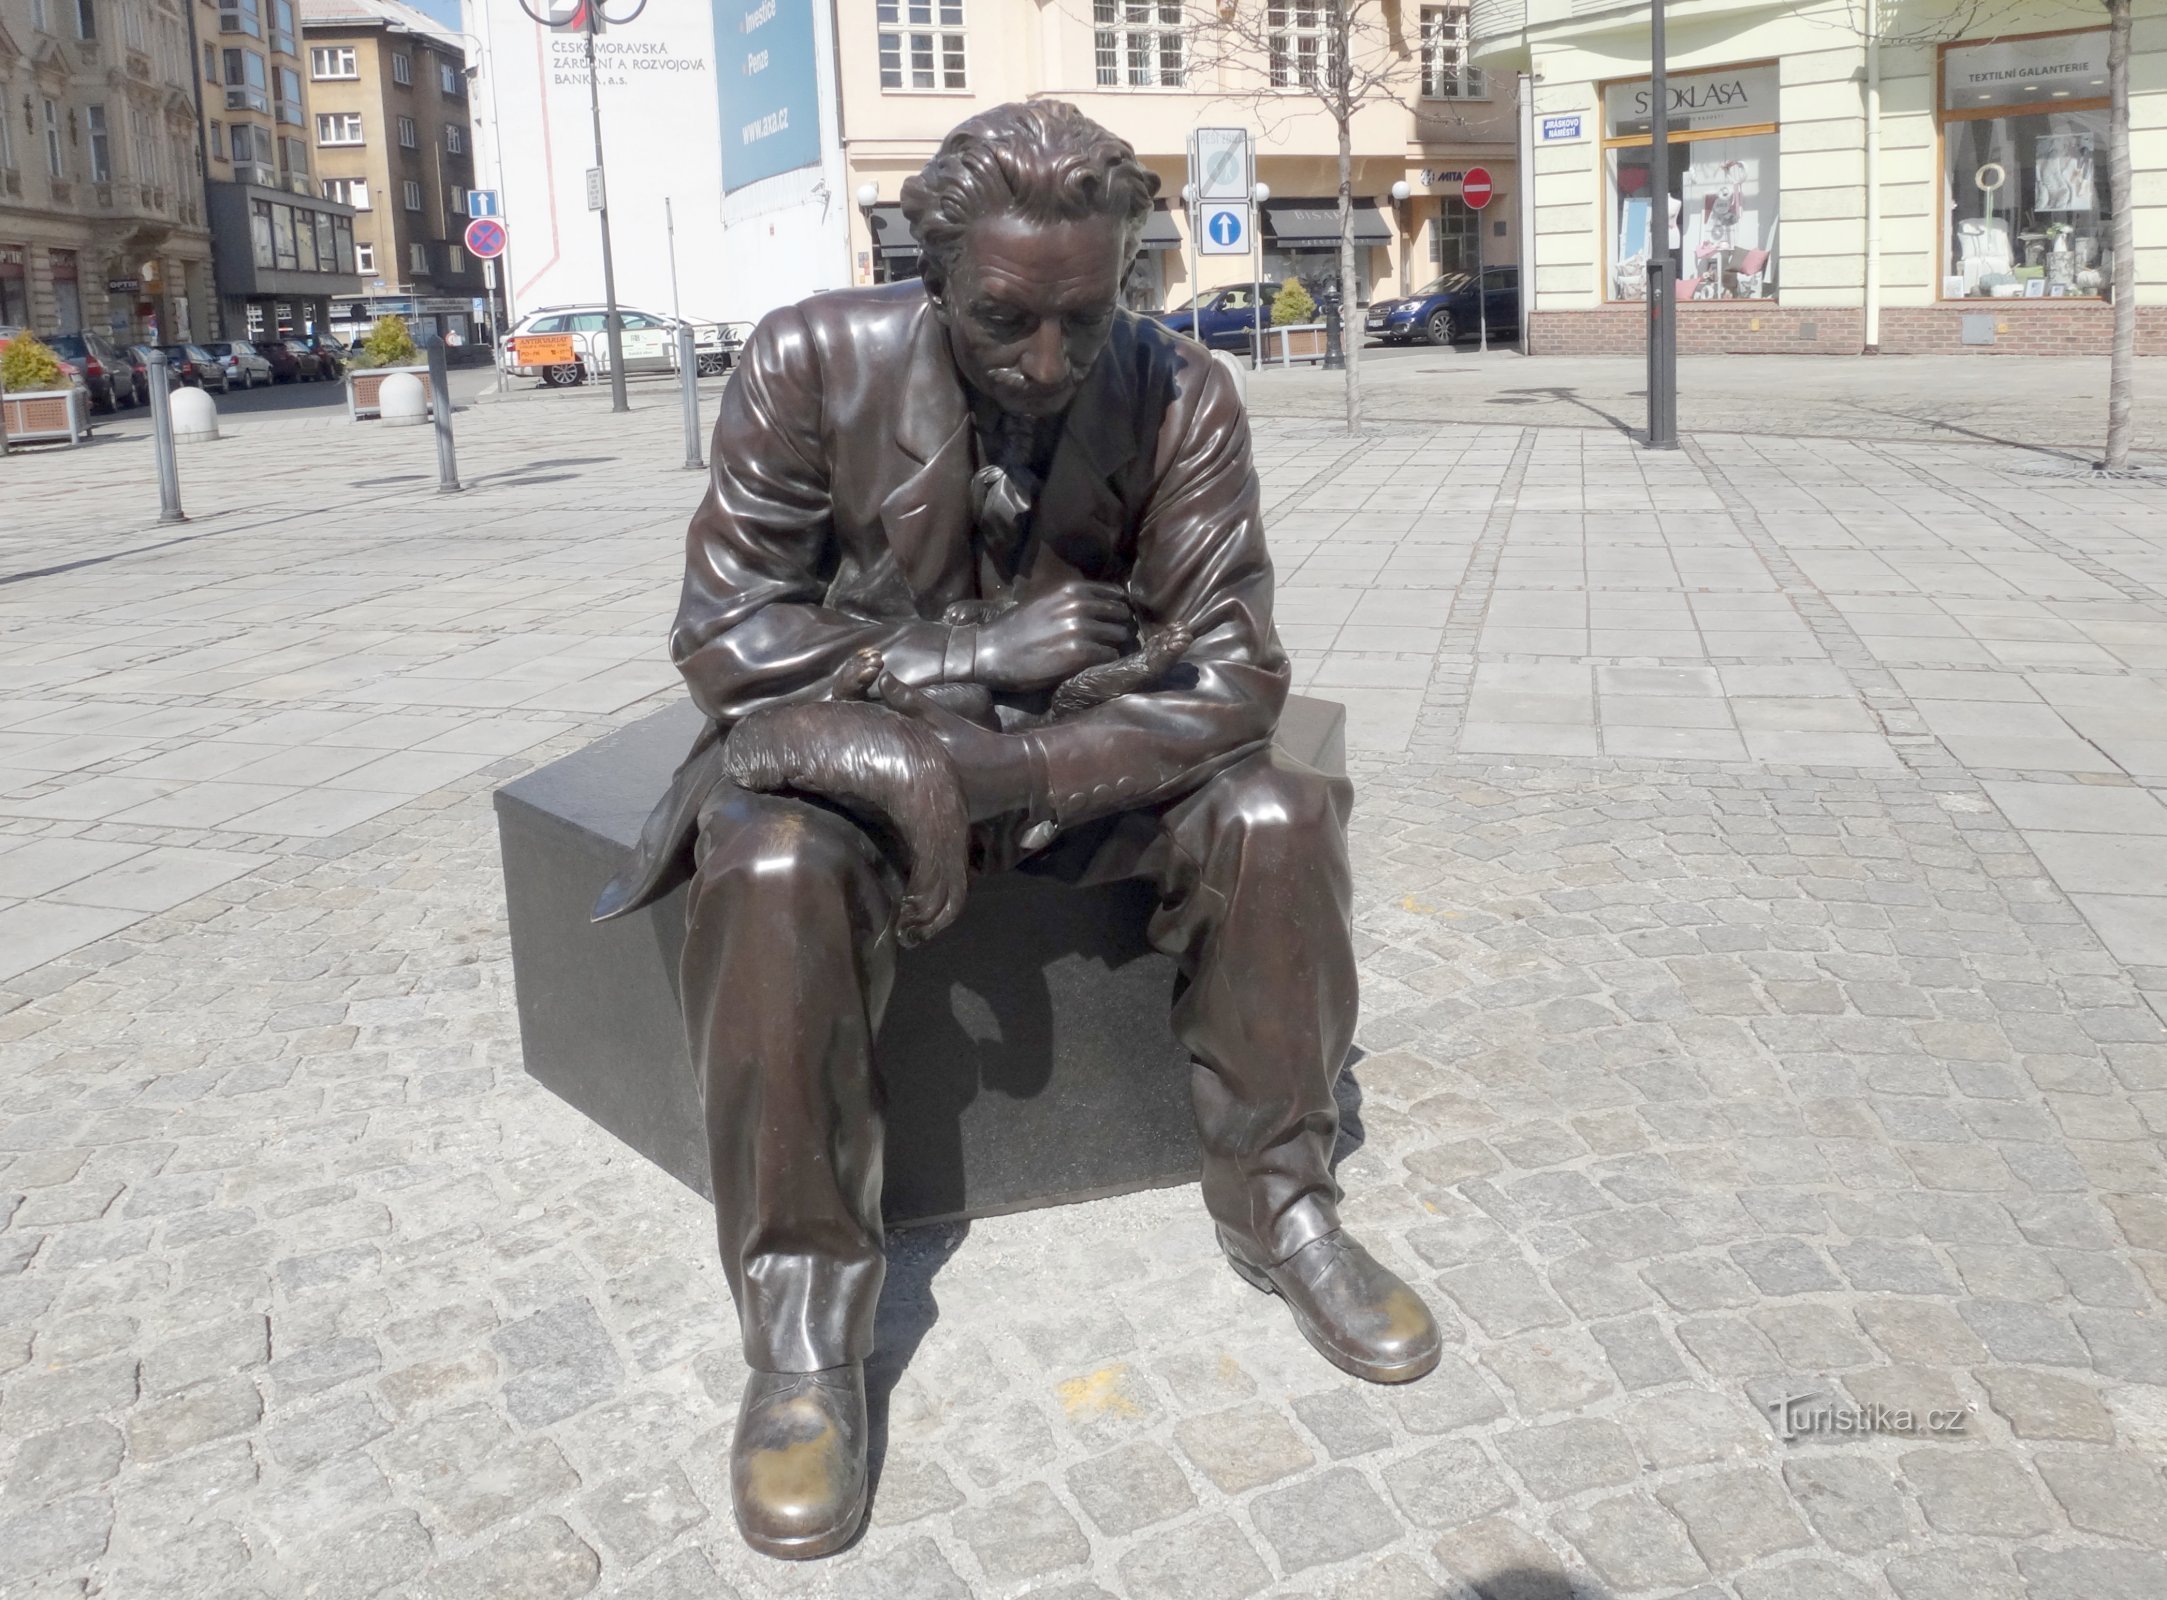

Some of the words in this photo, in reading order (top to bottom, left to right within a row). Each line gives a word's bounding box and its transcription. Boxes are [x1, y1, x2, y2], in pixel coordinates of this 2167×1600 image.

[553, 57, 612, 69] ZÁRUNÍ
[618, 59, 627, 69] A
[633, 58, 705, 72] ROZVOJOVÁ
[748, 49, 769, 76] Penze
[1968, 68, 2017, 82] TEXTILNÍ
[2019, 62, 2090, 77] GALANTERIE
[608, 77, 628, 86] a.s.
[1635, 80, 1748, 114] SOKLASA
[743, 107, 789, 145] www.axa.cz
[1545, 118, 1579, 130] JIRÁSKOVO
[1549, 126, 1576, 138] NÁMĚSTÍ
[1438, 171, 1467, 182] MITA
